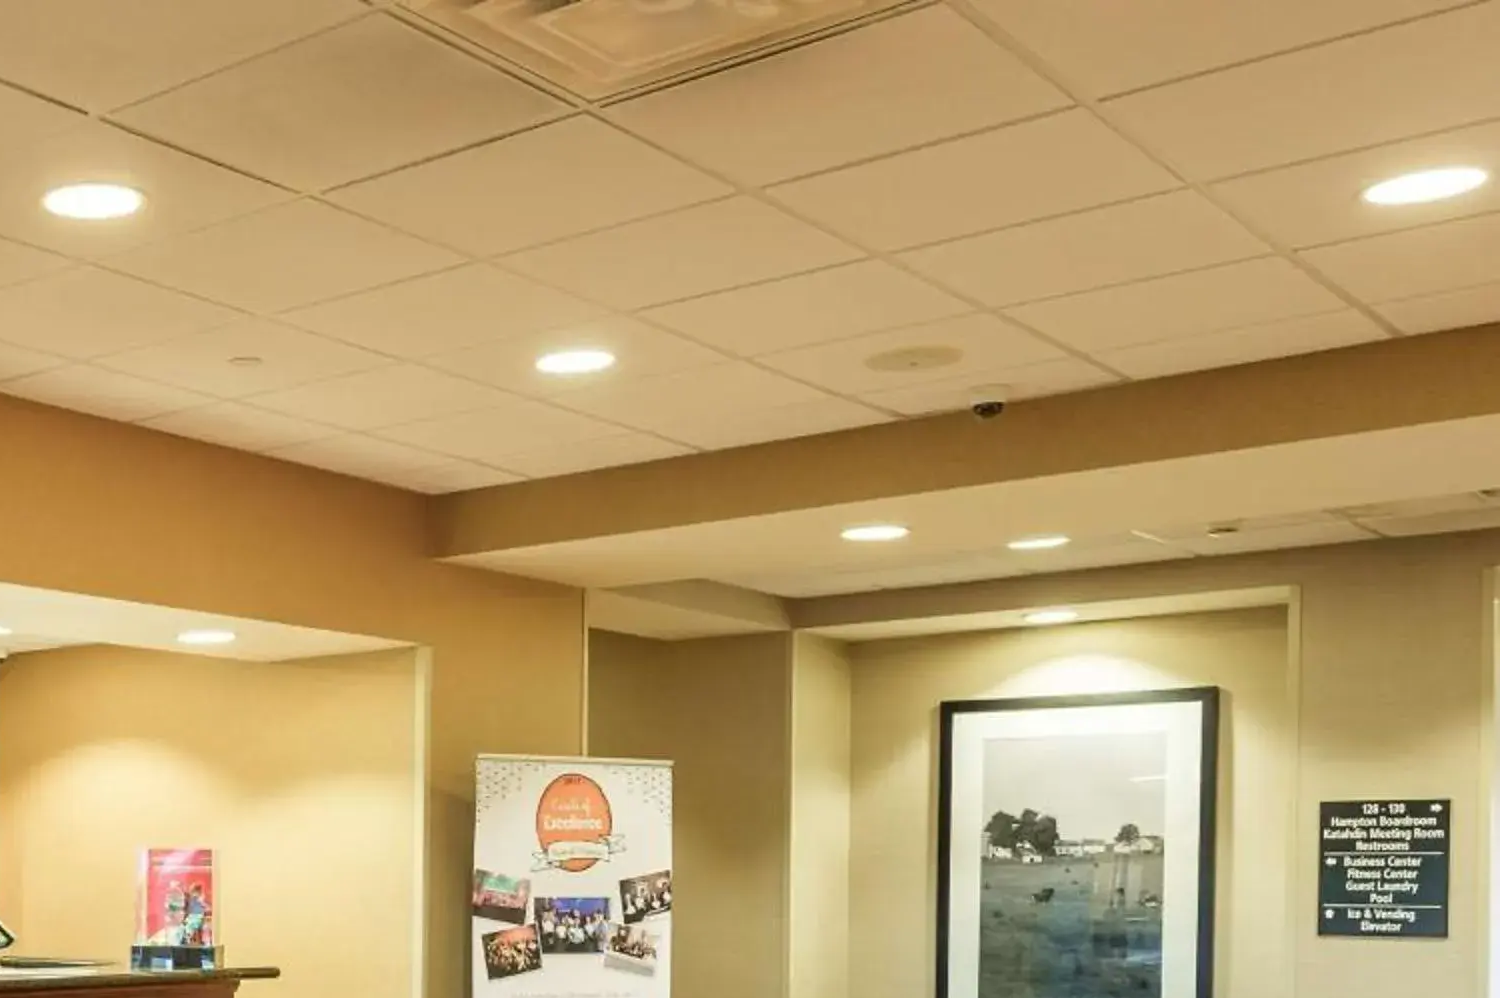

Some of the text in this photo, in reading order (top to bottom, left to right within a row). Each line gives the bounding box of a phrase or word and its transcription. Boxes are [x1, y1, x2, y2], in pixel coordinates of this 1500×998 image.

[1330, 815, 1438, 828] Hampton Boardroom
[1368, 828, 1412, 841] Meeting
[1413, 828, 1445, 839] Room
[1355, 840, 1410, 851] Restrooms
[1343, 856, 1422, 867] Business Center
[1347, 868, 1419, 879] Fitness Center
[1345, 880, 1419, 894] Guest Laundry
[1369, 892, 1393, 903] Pool
[1347, 908, 1416, 923] Ice & Vending
[1360, 921, 1402, 932] Elevator
